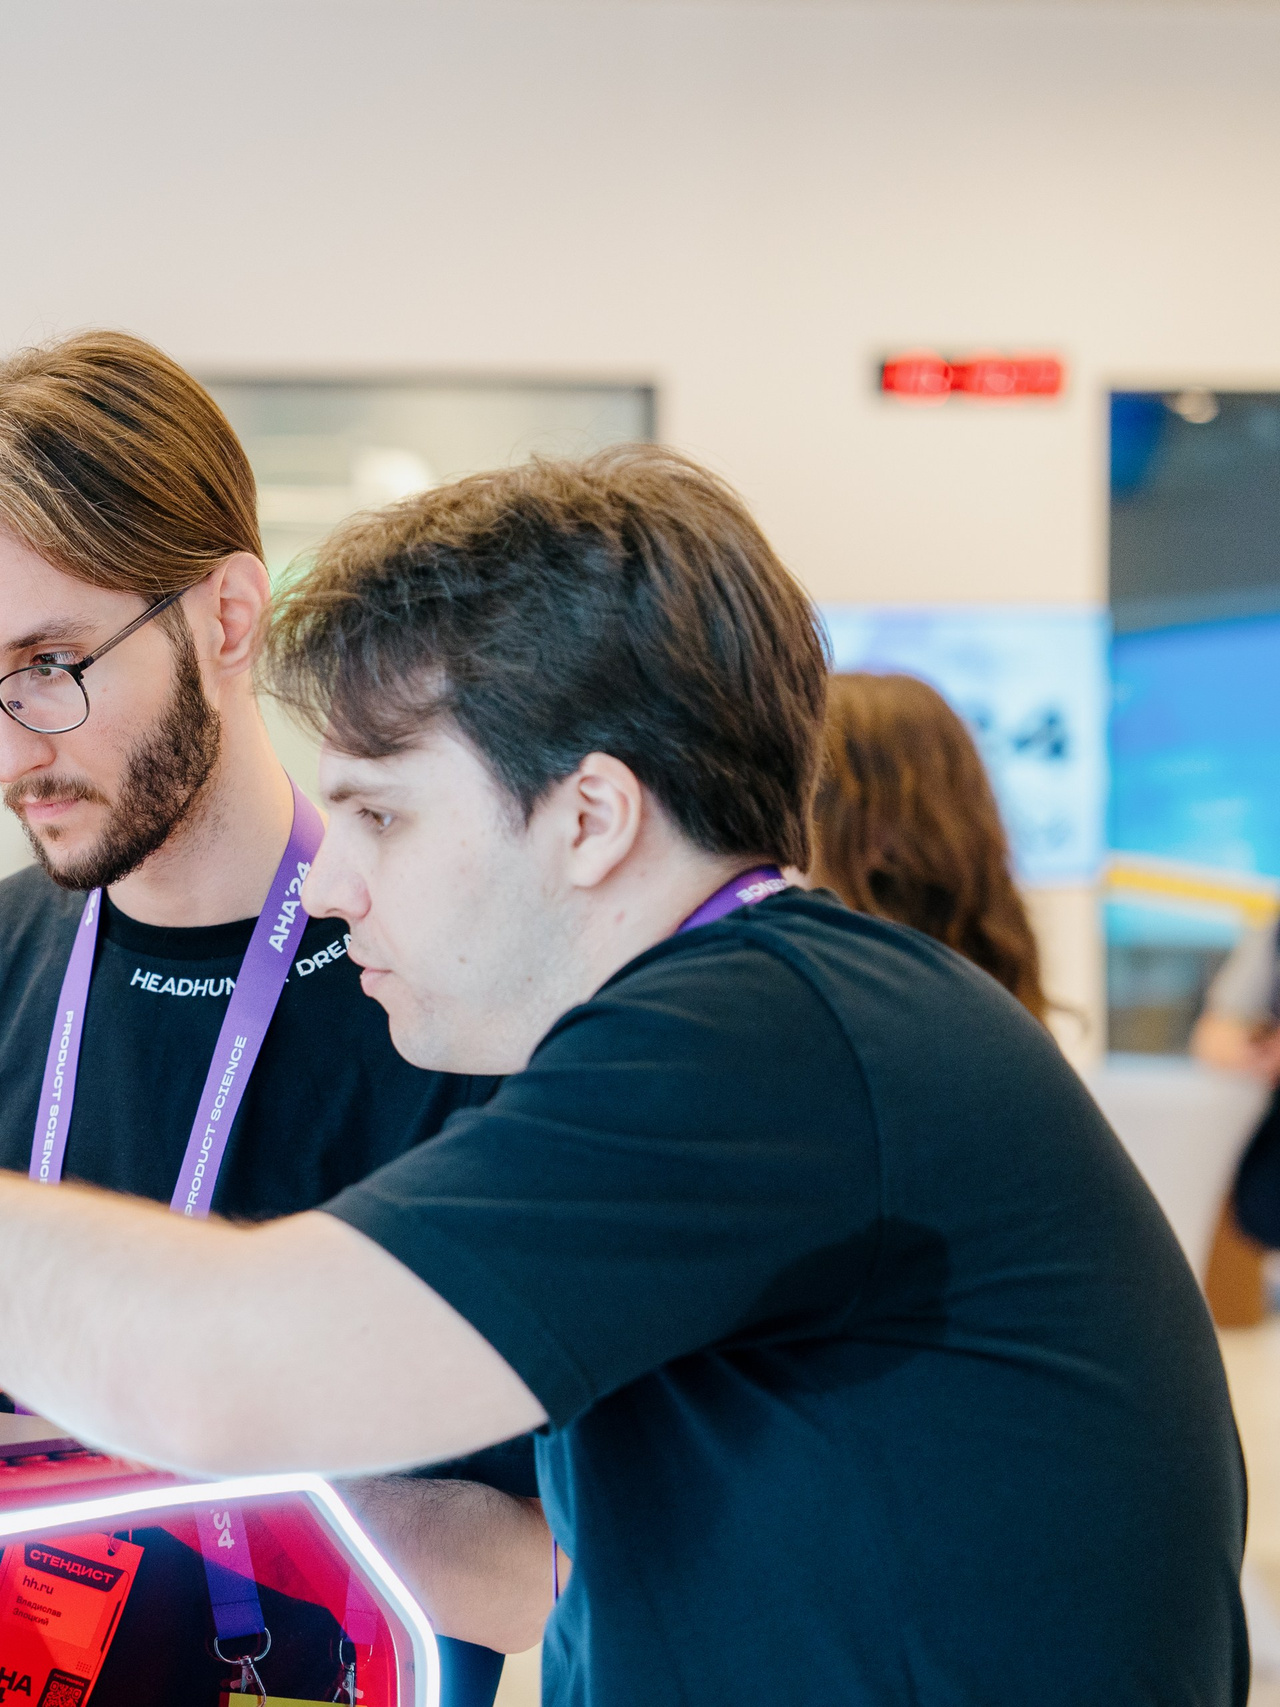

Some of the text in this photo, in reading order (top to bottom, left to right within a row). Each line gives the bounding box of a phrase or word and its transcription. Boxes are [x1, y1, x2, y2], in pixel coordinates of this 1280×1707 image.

[130, 933, 352, 997] HEADHUN DREA
[52, 1010, 74, 1102] PRODUCT
[184, 1035, 247, 1217] PRODUCT SCIENCE
[22, 1575, 54, 1595] hh.ru
[29, 1549, 114, 1585] СТЕНДИСТ
[15, 1595, 62, 1618] Владислав
